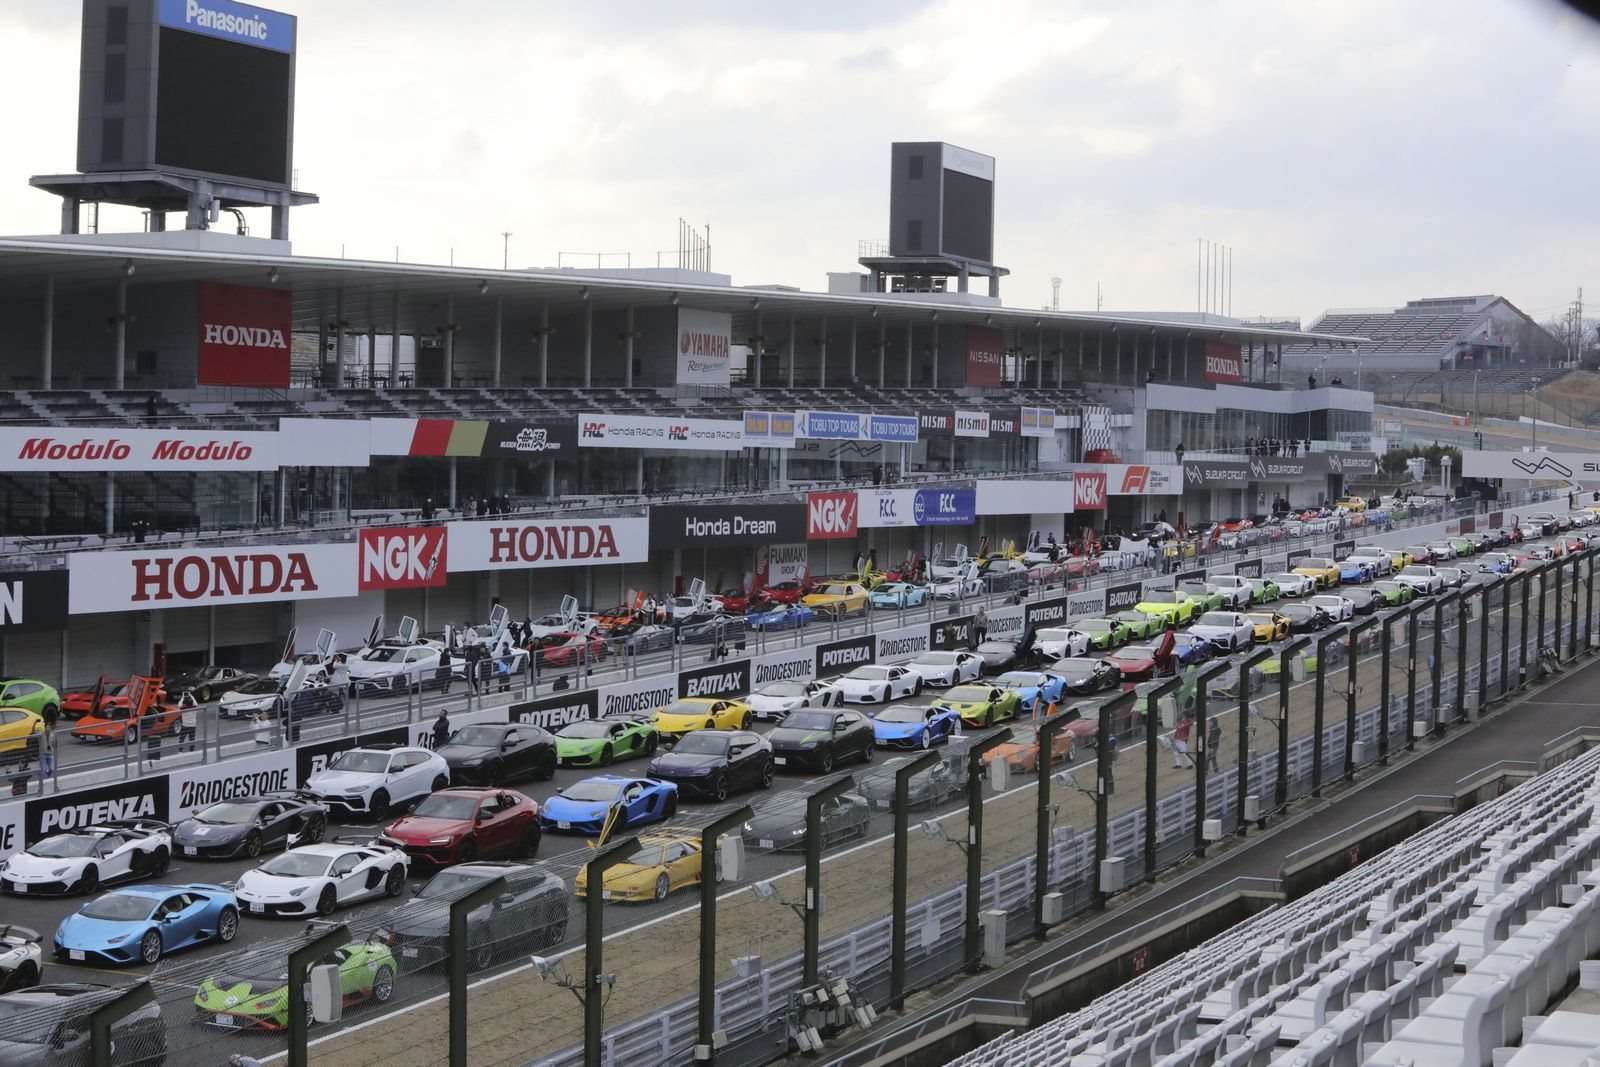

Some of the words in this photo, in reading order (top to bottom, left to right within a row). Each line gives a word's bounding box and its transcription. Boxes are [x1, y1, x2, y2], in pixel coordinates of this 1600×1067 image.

[185, 0, 268, 40] Panasonic
[204, 324, 287, 349] HONDA
[691, 332, 729, 358] YAMAHA
[969, 351, 999, 365] NISSAN
[1205, 355, 1240, 377] HONDA
[583, 422, 606, 438] HRC
[608, 427, 635, 436] Honda
[636, 428, 664, 437] RACING
[669, 425, 689, 440] HRC
[691, 431, 716, 439] Honda
[716, 431, 741, 440] RACING
[811, 418, 826, 431] TOBU
[827, 419, 840, 432] TOP
[841, 420, 859, 433] TOURS
[873, 421, 888, 434] TOBU
[888, 422, 899, 435] TOP
[899, 423, 916, 436] TOURS
[18, 438, 131, 460] Modulo
[152, 440, 253, 461] Modulo
[1205, 469, 1227, 479] SUZUKA
[1227, 470, 1247, 480] CIRCUIT
[1075, 476, 1099, 505] NGK
[685, 517, 730, 536] Honda
[734, 516, 777, 534] Dream
[809, 499, 848, 533] NGK
[489, 525, 620, 563] HONDA
[363, 533, 428, 582] NGK
[770, 546, 807, 565] FUJIMAKI
[131, 553, 318, 601] HONDA
[781, 566, 795, 575] GROUP
[986, 616, 1022, 634] RIDGESTONE
[1029, 605, 1064, 623] POTENZA
[822, 644, 870, 667] POTENZA
[880, 635, 927, 657] BRIDGESTONE
[755, 659, 813, 684] BRIDGESTONE
[687, 671, 743, 698] BATTLAX
[605, 687, 674, 716] BRIDGESTONE
[519, 704, 590, 728] POTENZA
[180, 768, 289, 809] BRIDGESTONE
[40, 793, 156, 833] POTENZA
